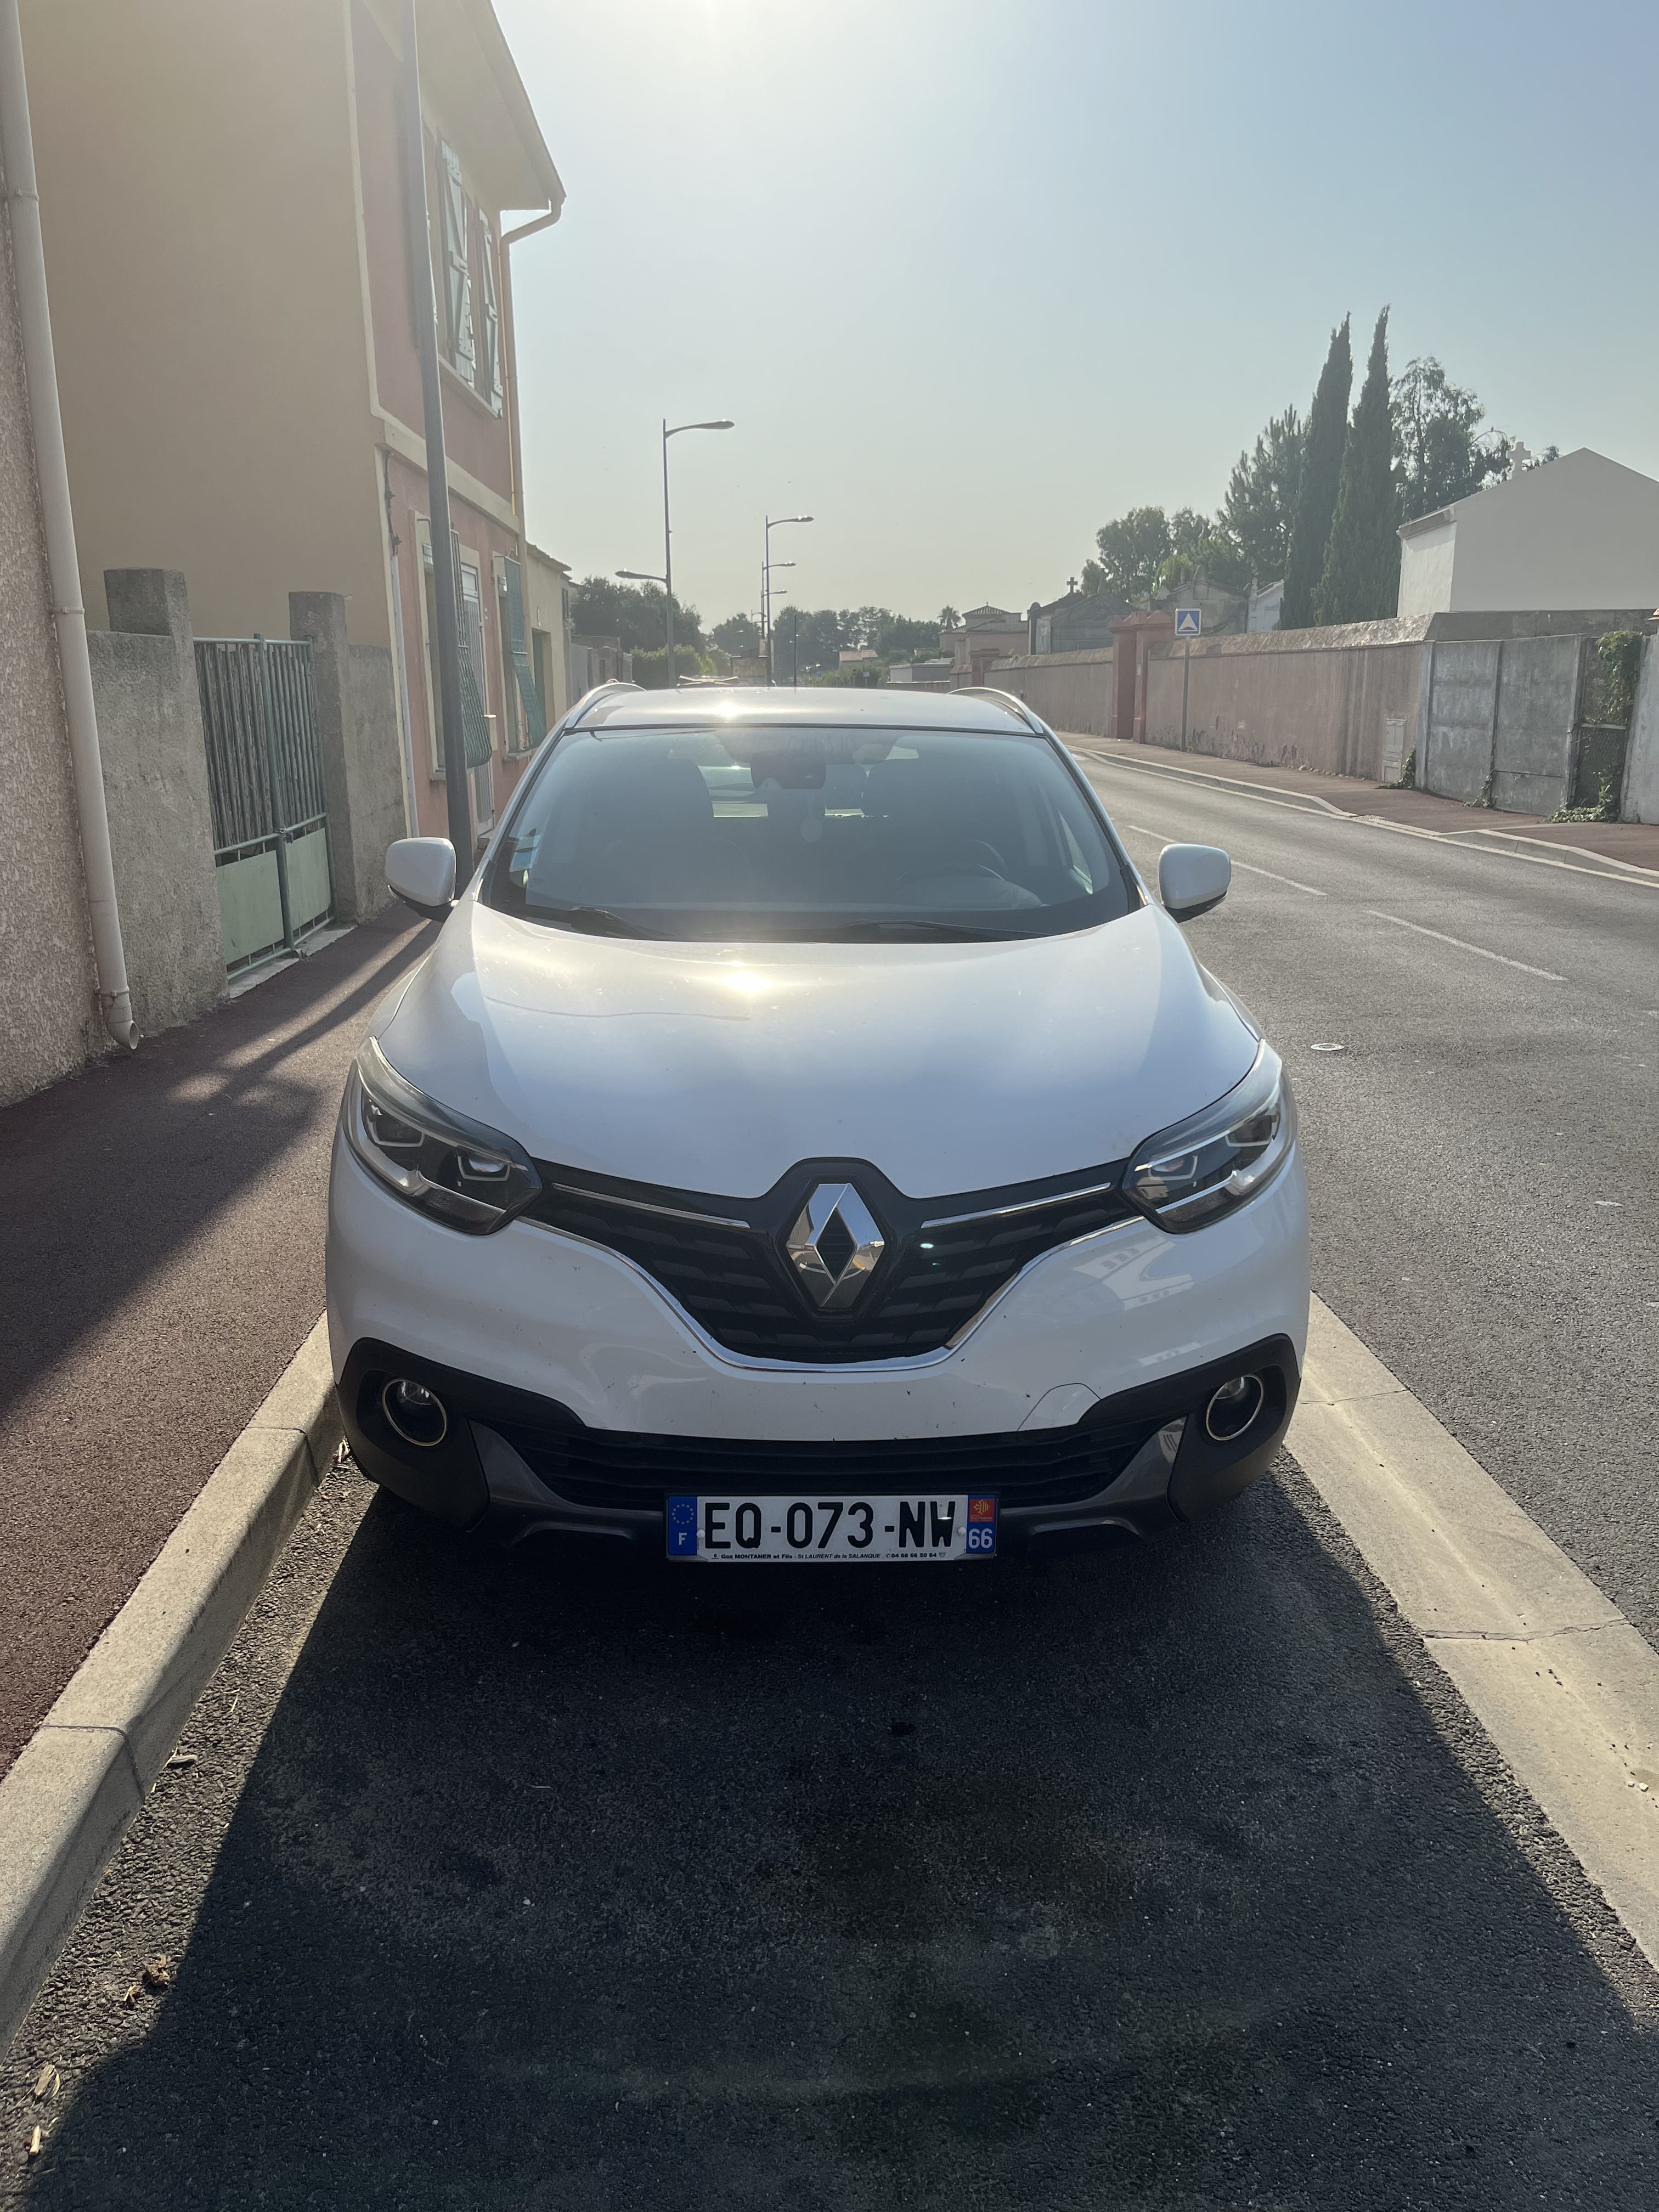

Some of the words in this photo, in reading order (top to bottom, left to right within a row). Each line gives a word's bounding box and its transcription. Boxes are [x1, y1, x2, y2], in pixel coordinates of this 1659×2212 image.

[704, 1501, 956, 1549] EQ-073-NW
[679, 1532, 687, 1545] F
[968, 1528, 993, 1549] 66
